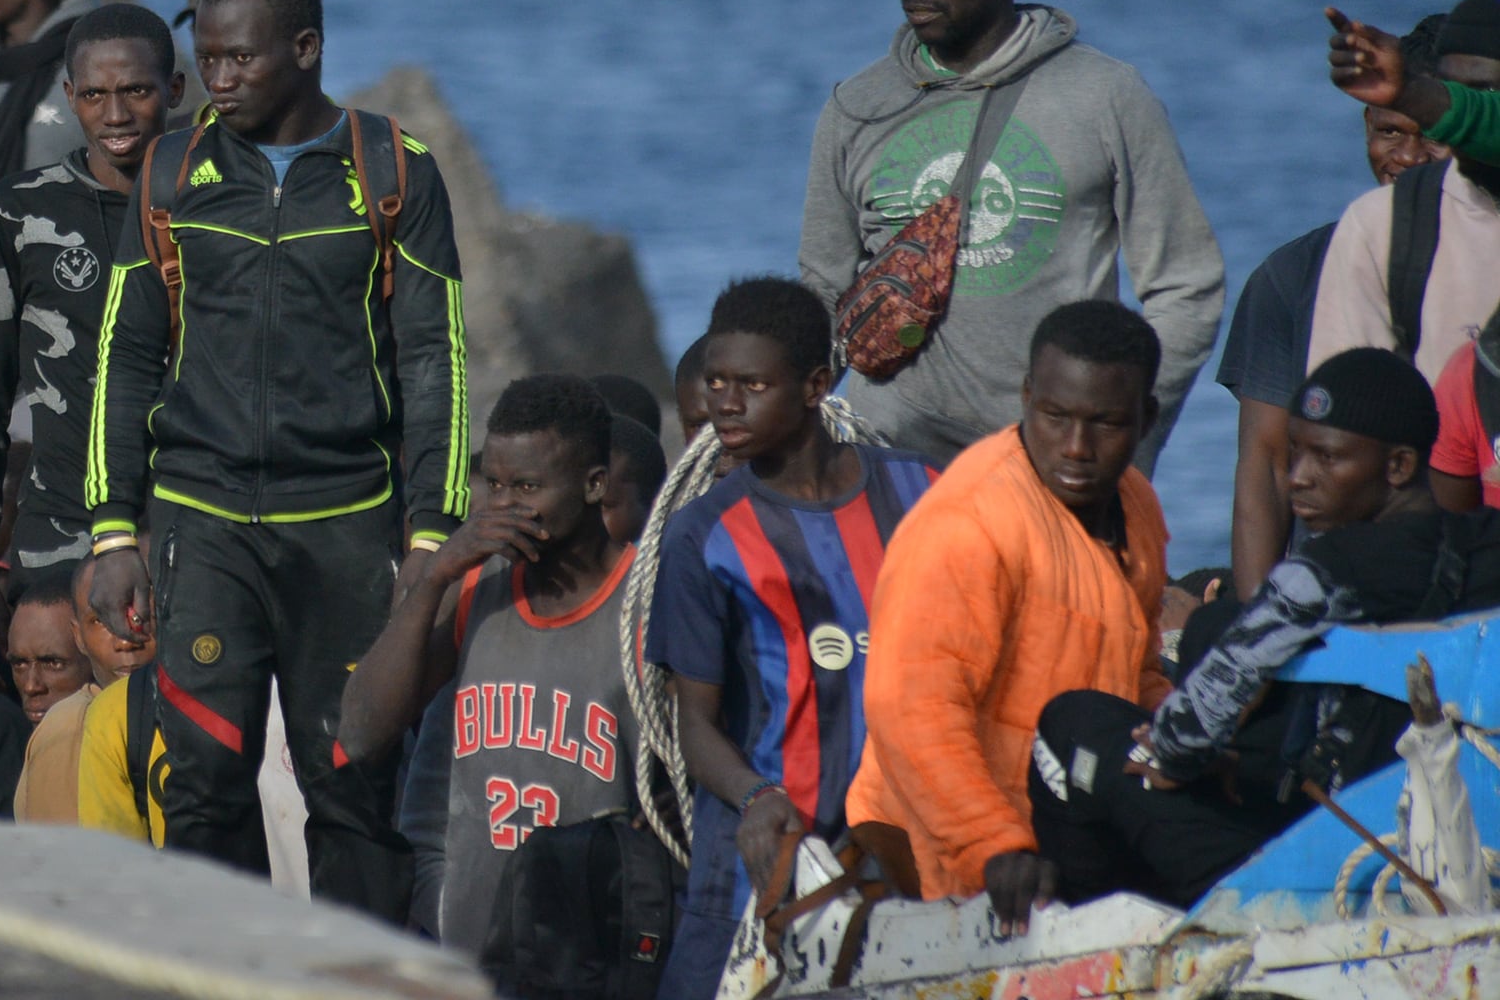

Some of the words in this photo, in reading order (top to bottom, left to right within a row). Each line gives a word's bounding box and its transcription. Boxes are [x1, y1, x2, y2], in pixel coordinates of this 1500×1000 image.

[190, 174, 222, 187] sports
[454, 683, 618, 783] BULLS
[486, 776, 560, 851] 23
